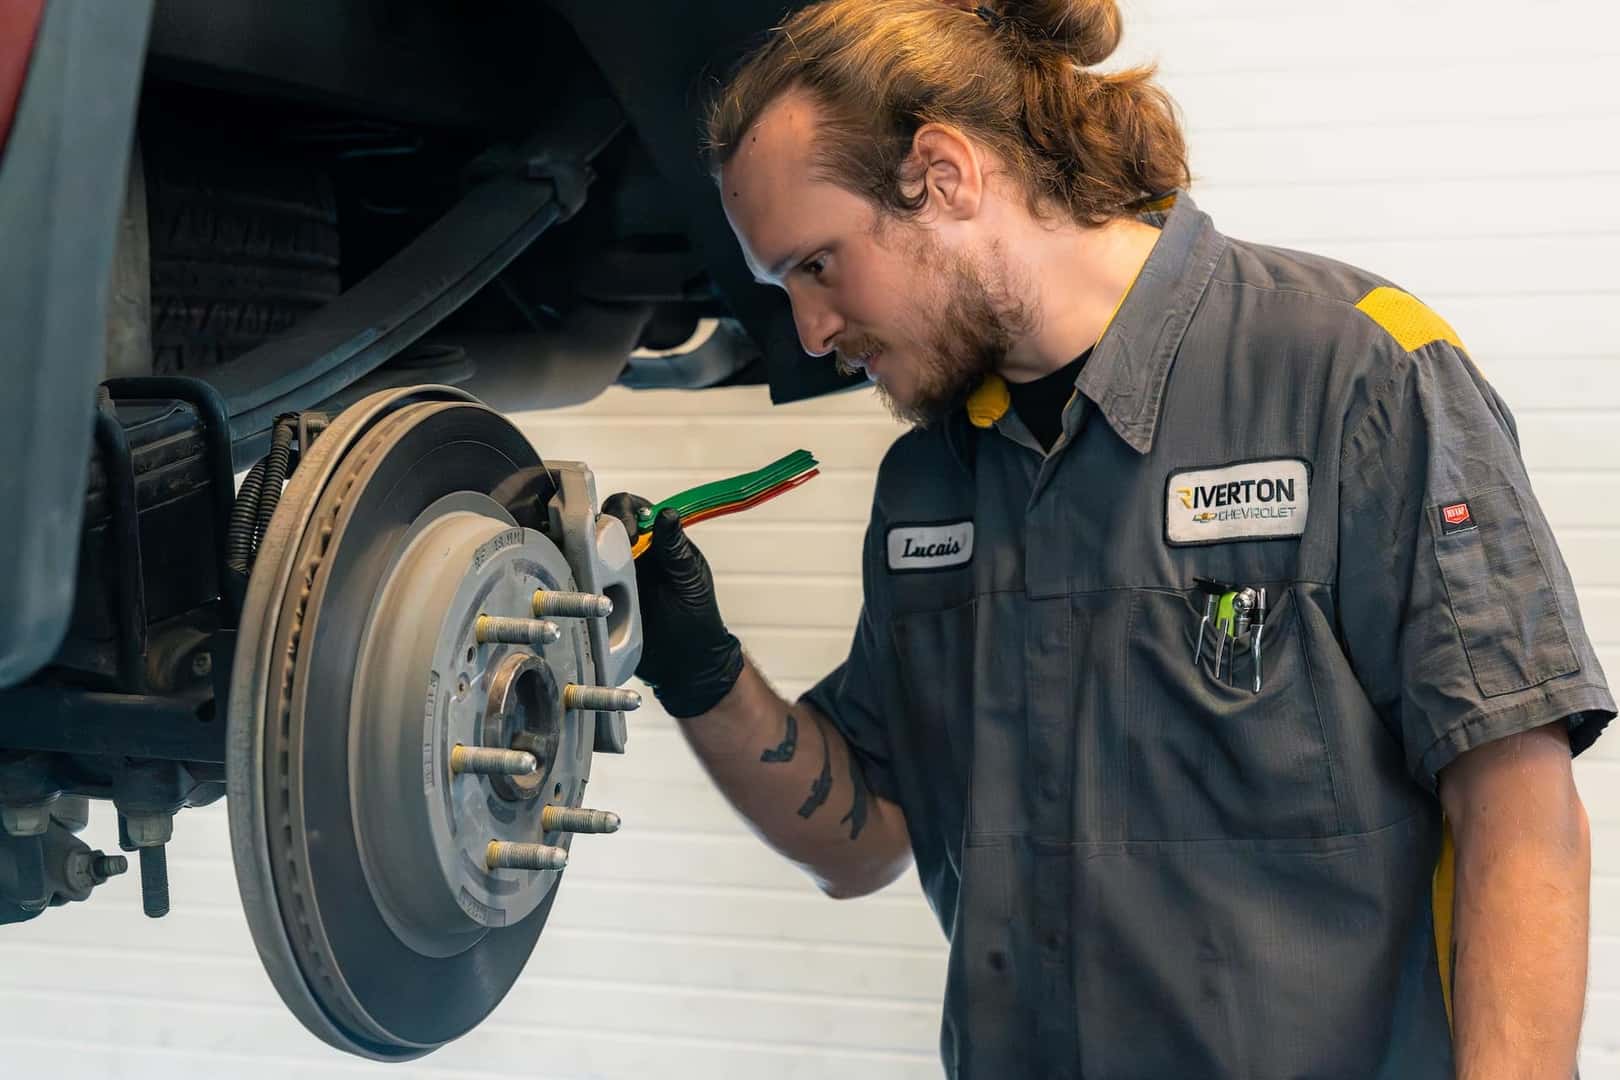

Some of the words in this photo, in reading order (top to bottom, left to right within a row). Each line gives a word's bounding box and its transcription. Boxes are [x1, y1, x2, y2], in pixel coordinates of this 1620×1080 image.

[1176, 478, 1295, 509] RIVERTON
[1218, 506, 1296, 521] CHEVROLET
[901, 537, 961, 558] Lucais
